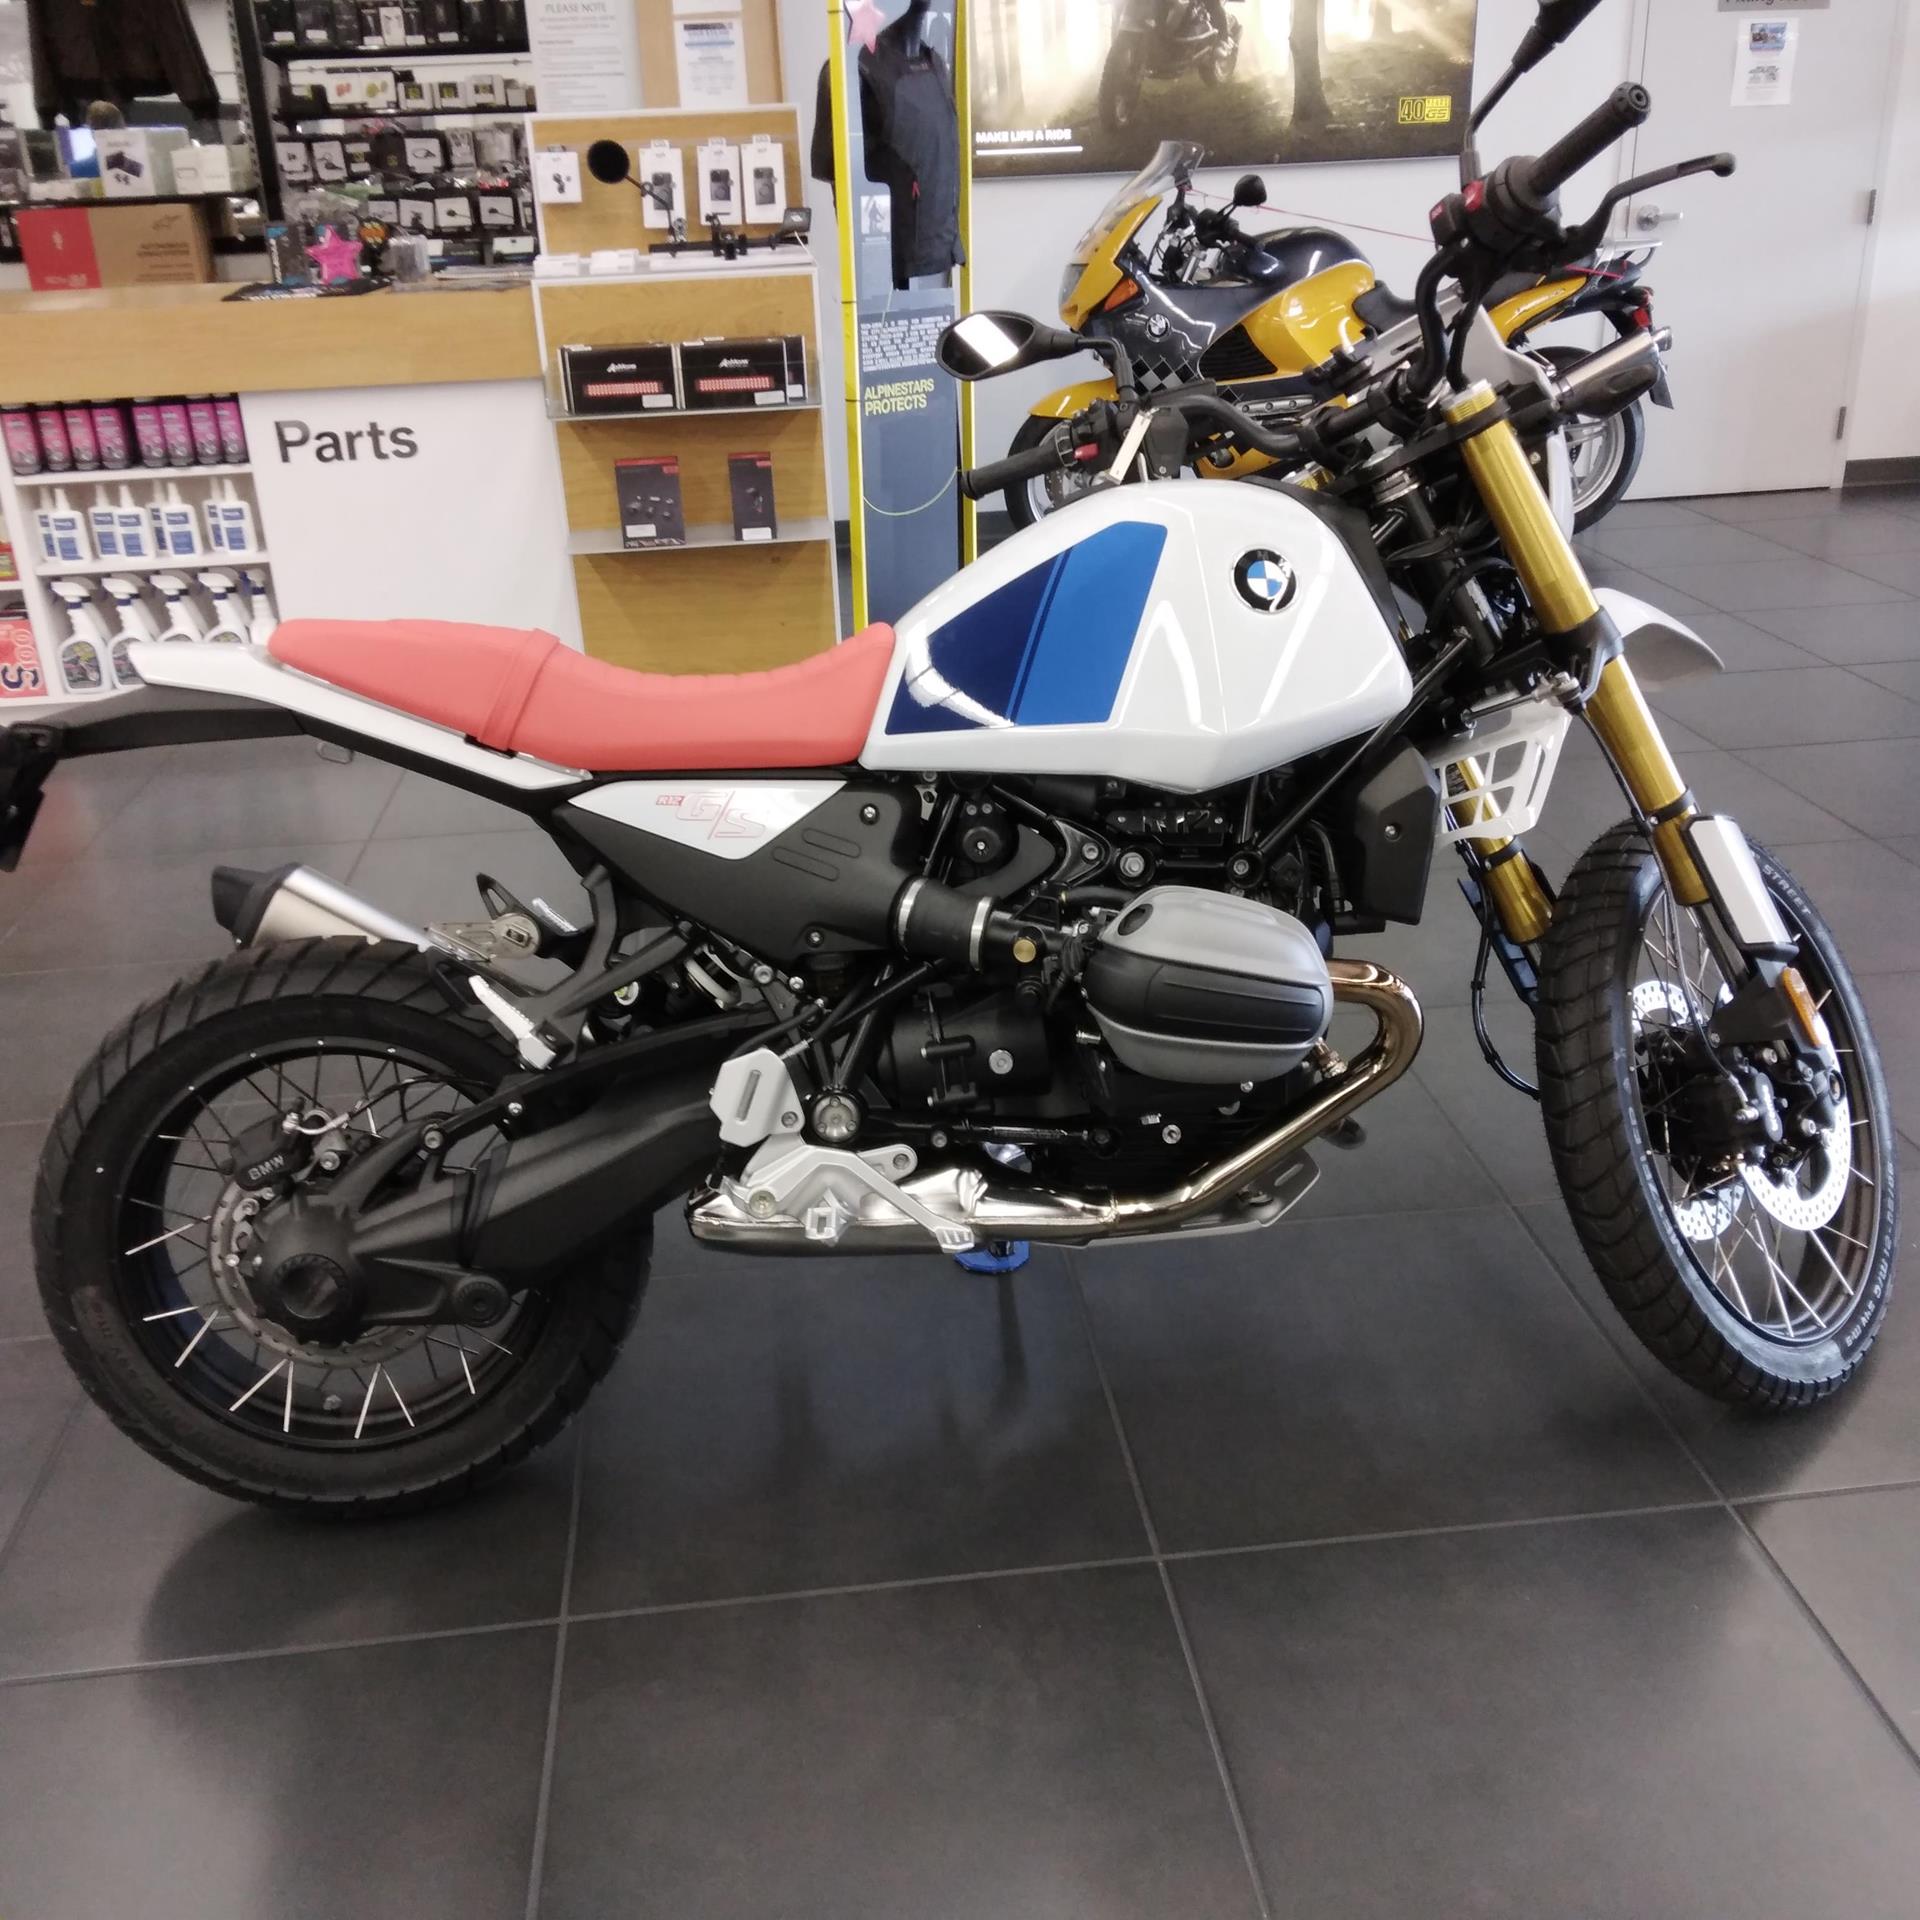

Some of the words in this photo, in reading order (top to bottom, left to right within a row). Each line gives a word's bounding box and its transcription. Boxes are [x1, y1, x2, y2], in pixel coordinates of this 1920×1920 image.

[545, 2, 579, 14] PLEASE
[581, 1, 608, 13] NOTE
[1401, 100, 1424, 120] 40
[976, 132, 1009, 143] MAKE
[1010, 130, 1034, 142] LIFE
[1035, 130, 1045, 141] A
[1045, 128, 1072, 140] RIDE
[864, 378, 935, 400] ALPINESTARS
[864, 394, 928, 416] PROTECTS
[274, 420, 418, 463] Parts
[1762, 864, 1811, 914] STREET
[247, 1155, 284, 1180] BMW
